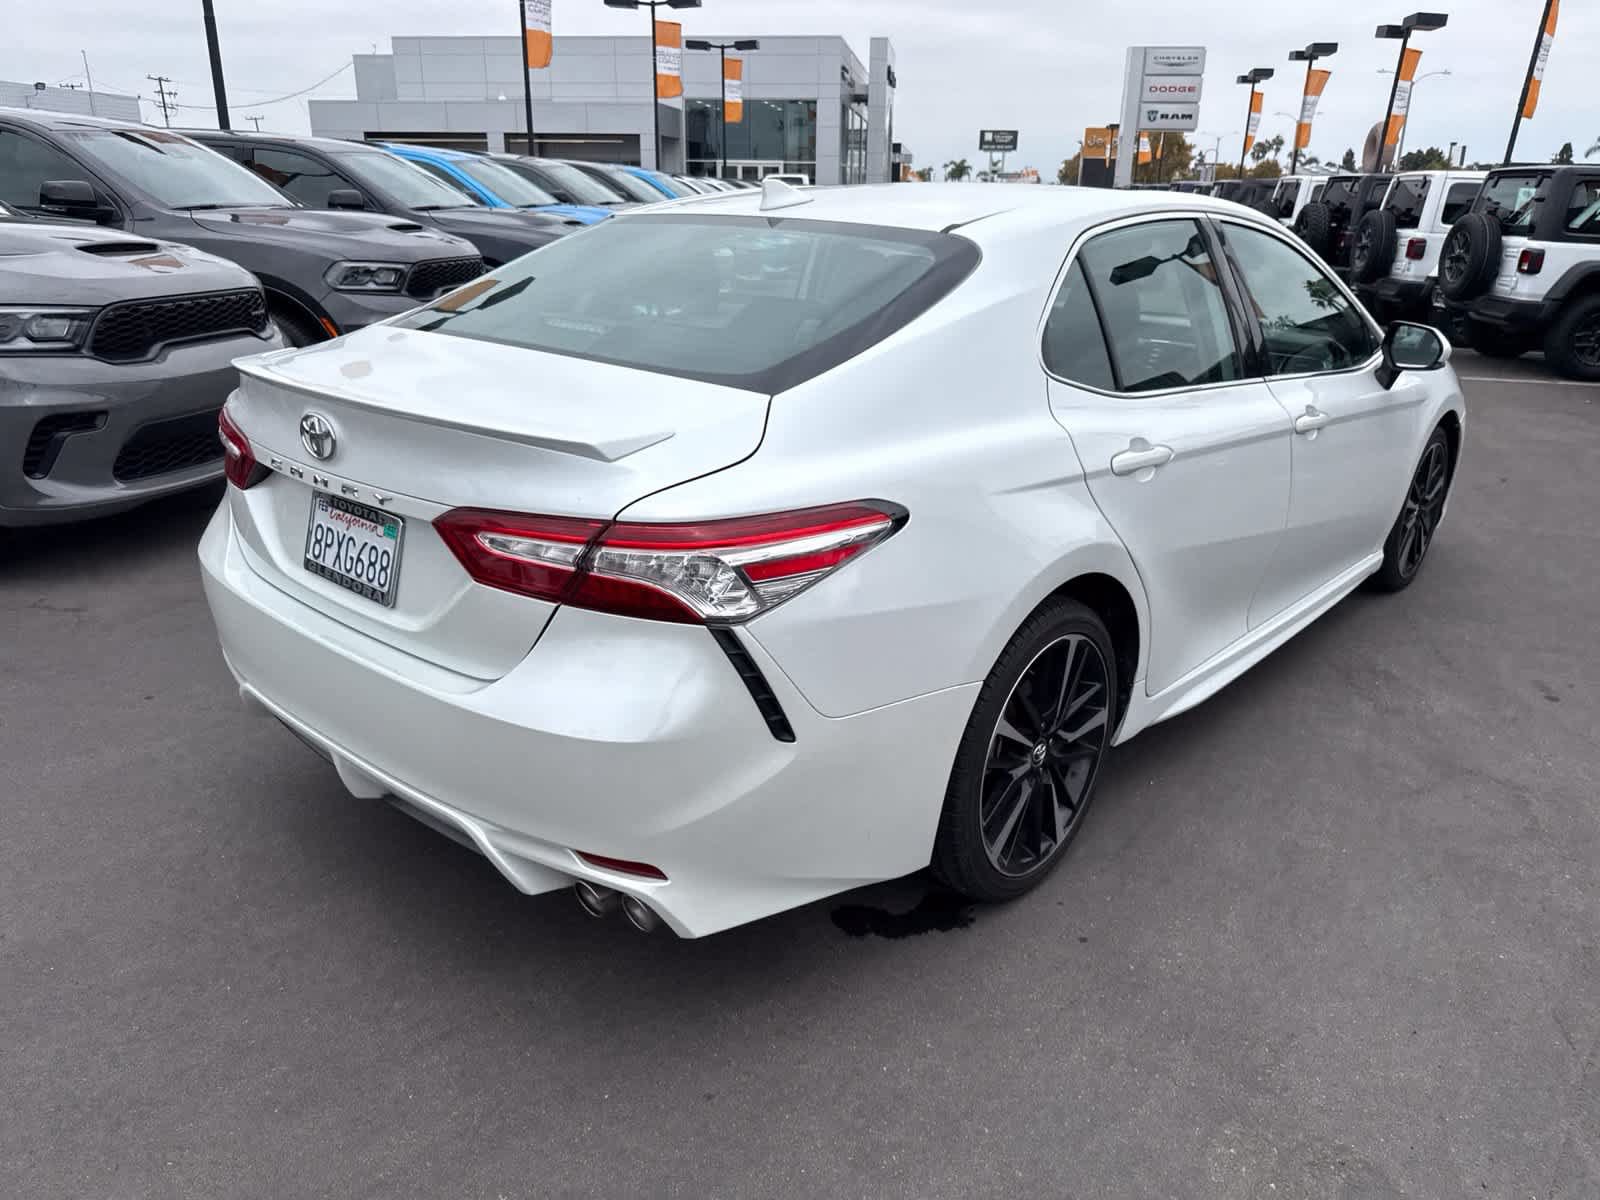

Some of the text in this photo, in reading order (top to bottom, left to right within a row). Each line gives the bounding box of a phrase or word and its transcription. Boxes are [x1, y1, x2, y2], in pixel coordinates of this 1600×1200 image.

[1149, 85, 1196, 93] DODGE
[271, 458, 392, 506] CAMRY
[332, 497, 378, 522] TOYOTA
[312, 523, 391, 588] 8PXG688
[307, 560, 385, 602] GLENDORA
